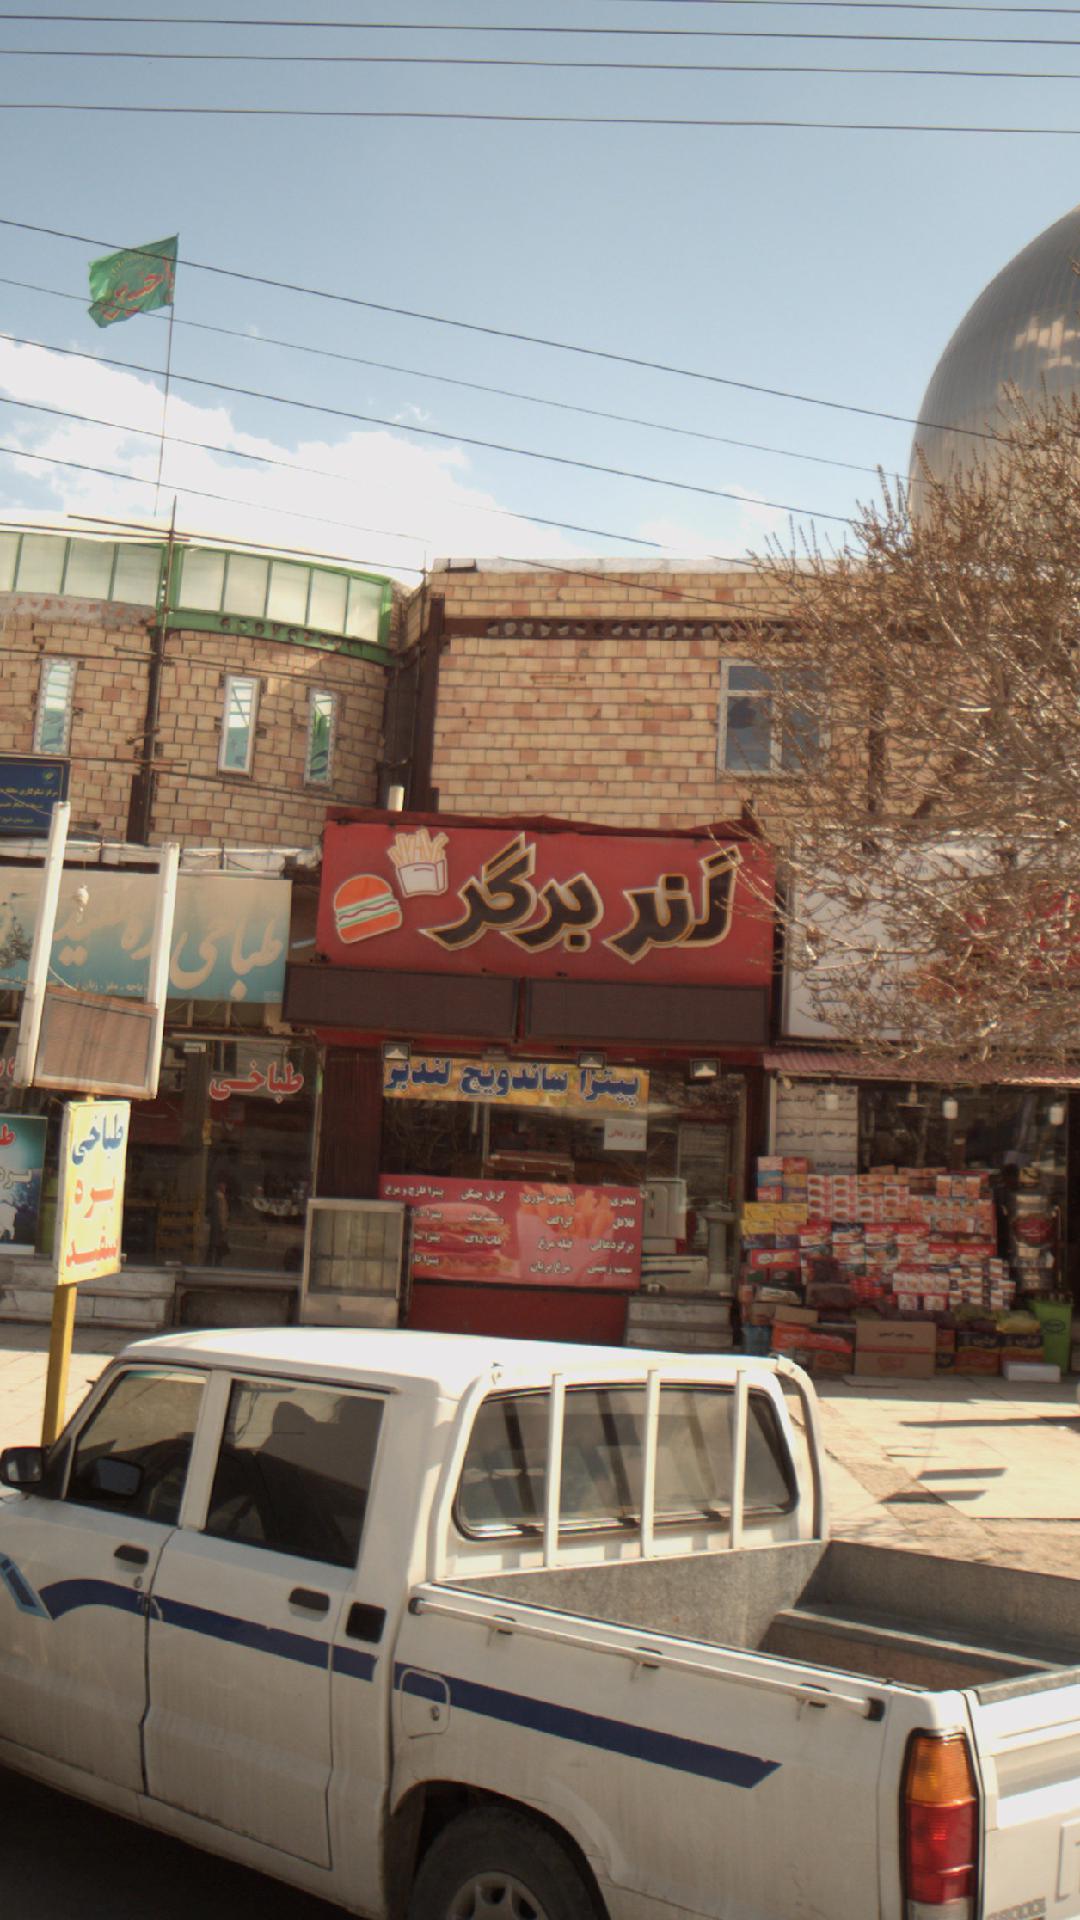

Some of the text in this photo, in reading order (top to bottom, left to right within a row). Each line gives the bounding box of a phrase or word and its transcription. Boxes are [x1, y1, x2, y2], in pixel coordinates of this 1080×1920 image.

[418, 832, 604, 954] برگر
[209, 1059, 305, 1103] طباخی
[460, 1064, 568, 1097] ساندویچ
[580, 1068, 640, 1107] پیتزا
[72, 1113, 124, 1166] طباخی
[74, 1177, 116, 1219] بره
